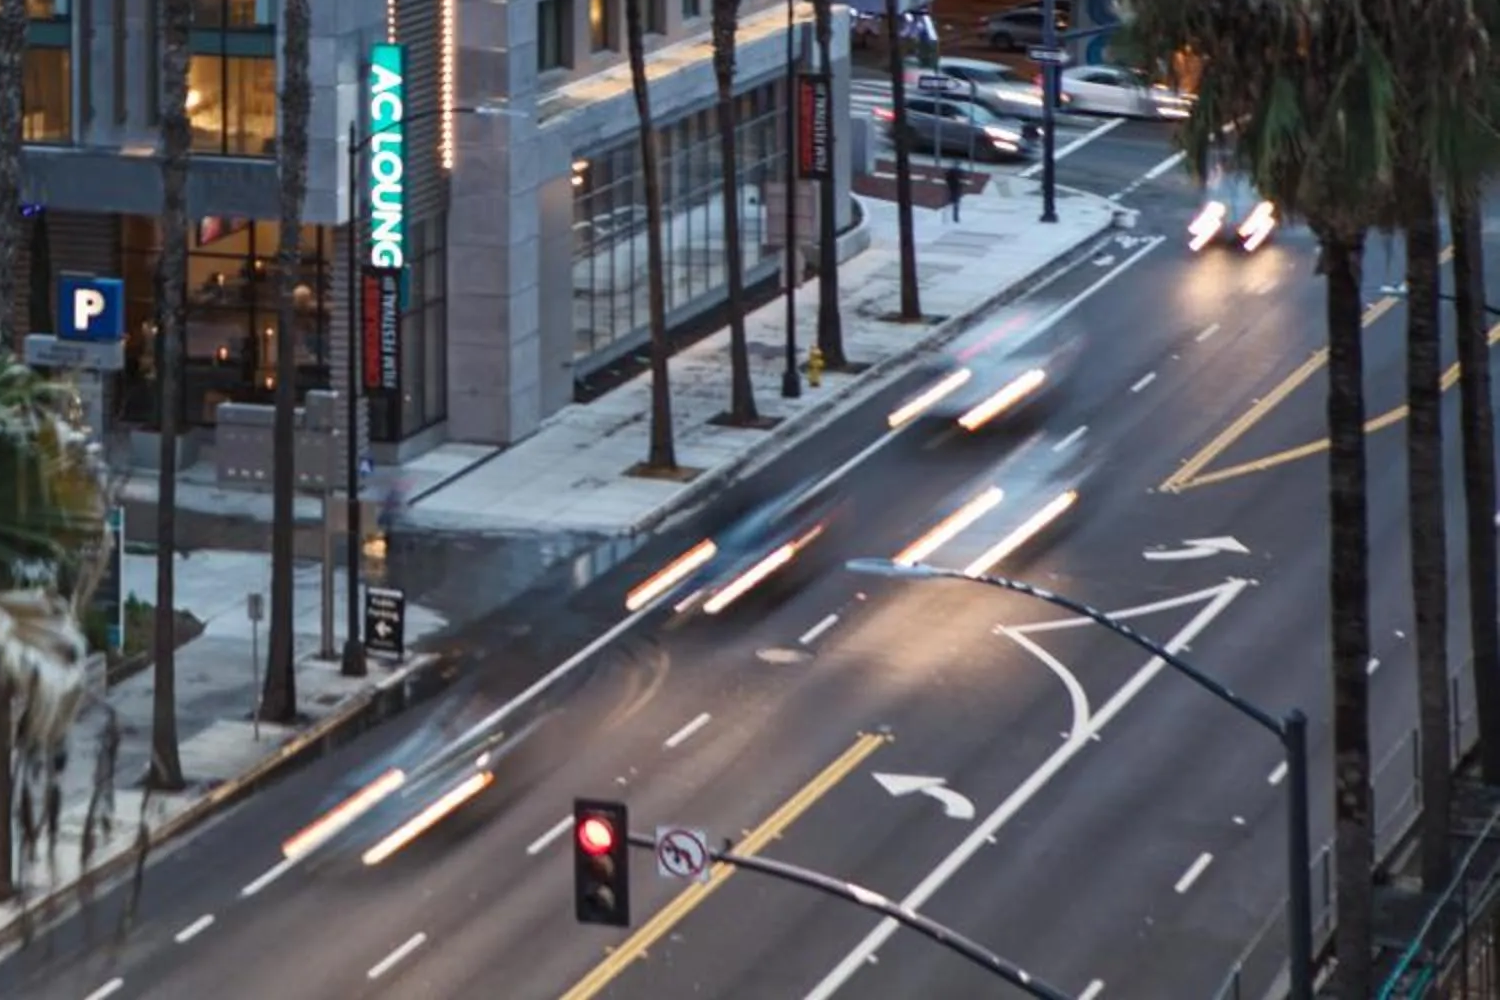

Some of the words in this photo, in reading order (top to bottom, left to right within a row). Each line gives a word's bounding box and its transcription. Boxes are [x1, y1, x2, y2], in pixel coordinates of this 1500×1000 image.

[371, 63, 403, 121] AC
[371, 132, 403, 269] LOUNG
[74, 288, 105, 331] P
